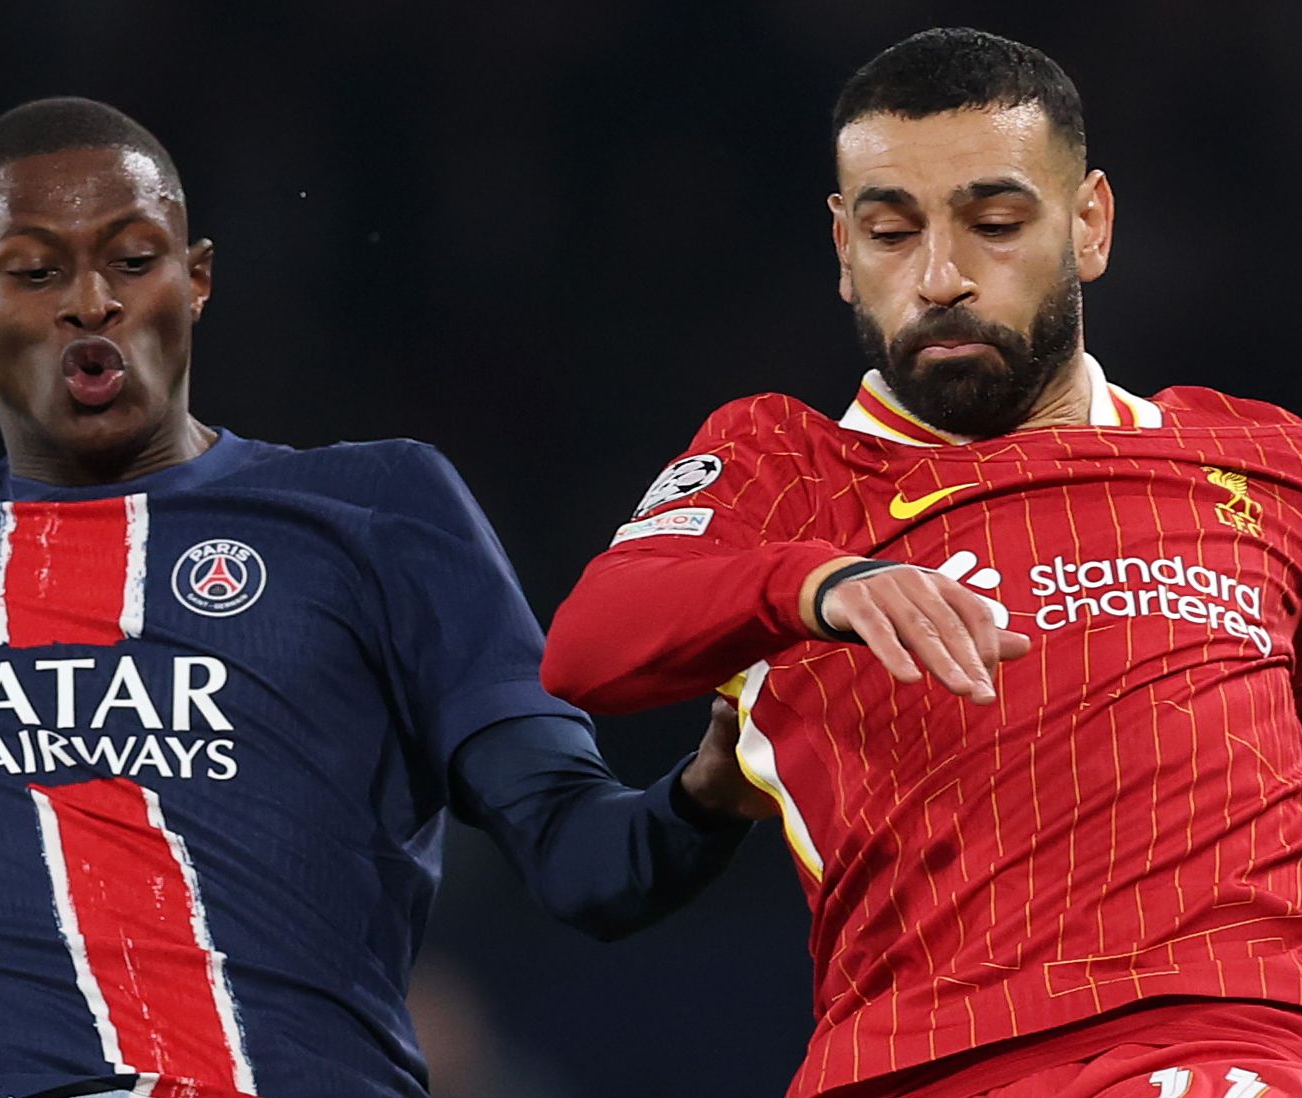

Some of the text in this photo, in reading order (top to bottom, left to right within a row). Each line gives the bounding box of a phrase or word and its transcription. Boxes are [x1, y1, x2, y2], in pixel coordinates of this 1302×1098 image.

[189, 543, 251, 562] PARIS
[1029, 555, 1261, 620] standard
[1035, 584, 1272, 659] chartered
